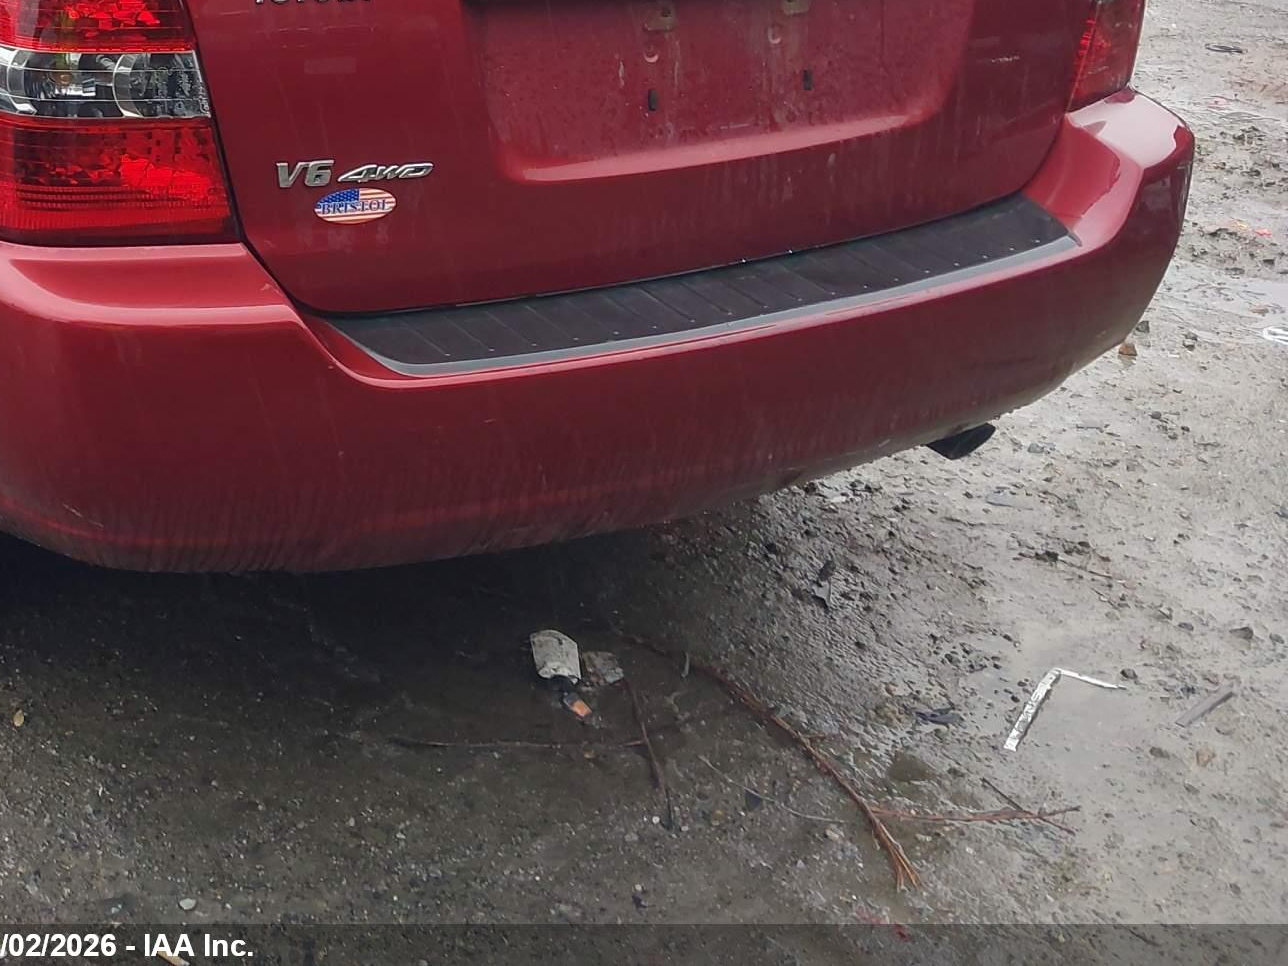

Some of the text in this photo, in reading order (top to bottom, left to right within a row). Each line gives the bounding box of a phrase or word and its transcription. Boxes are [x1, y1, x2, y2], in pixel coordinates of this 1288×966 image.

[276, 159, 434, 188] V6 4WD
[321, 199, 392, 215] BRISTOL
